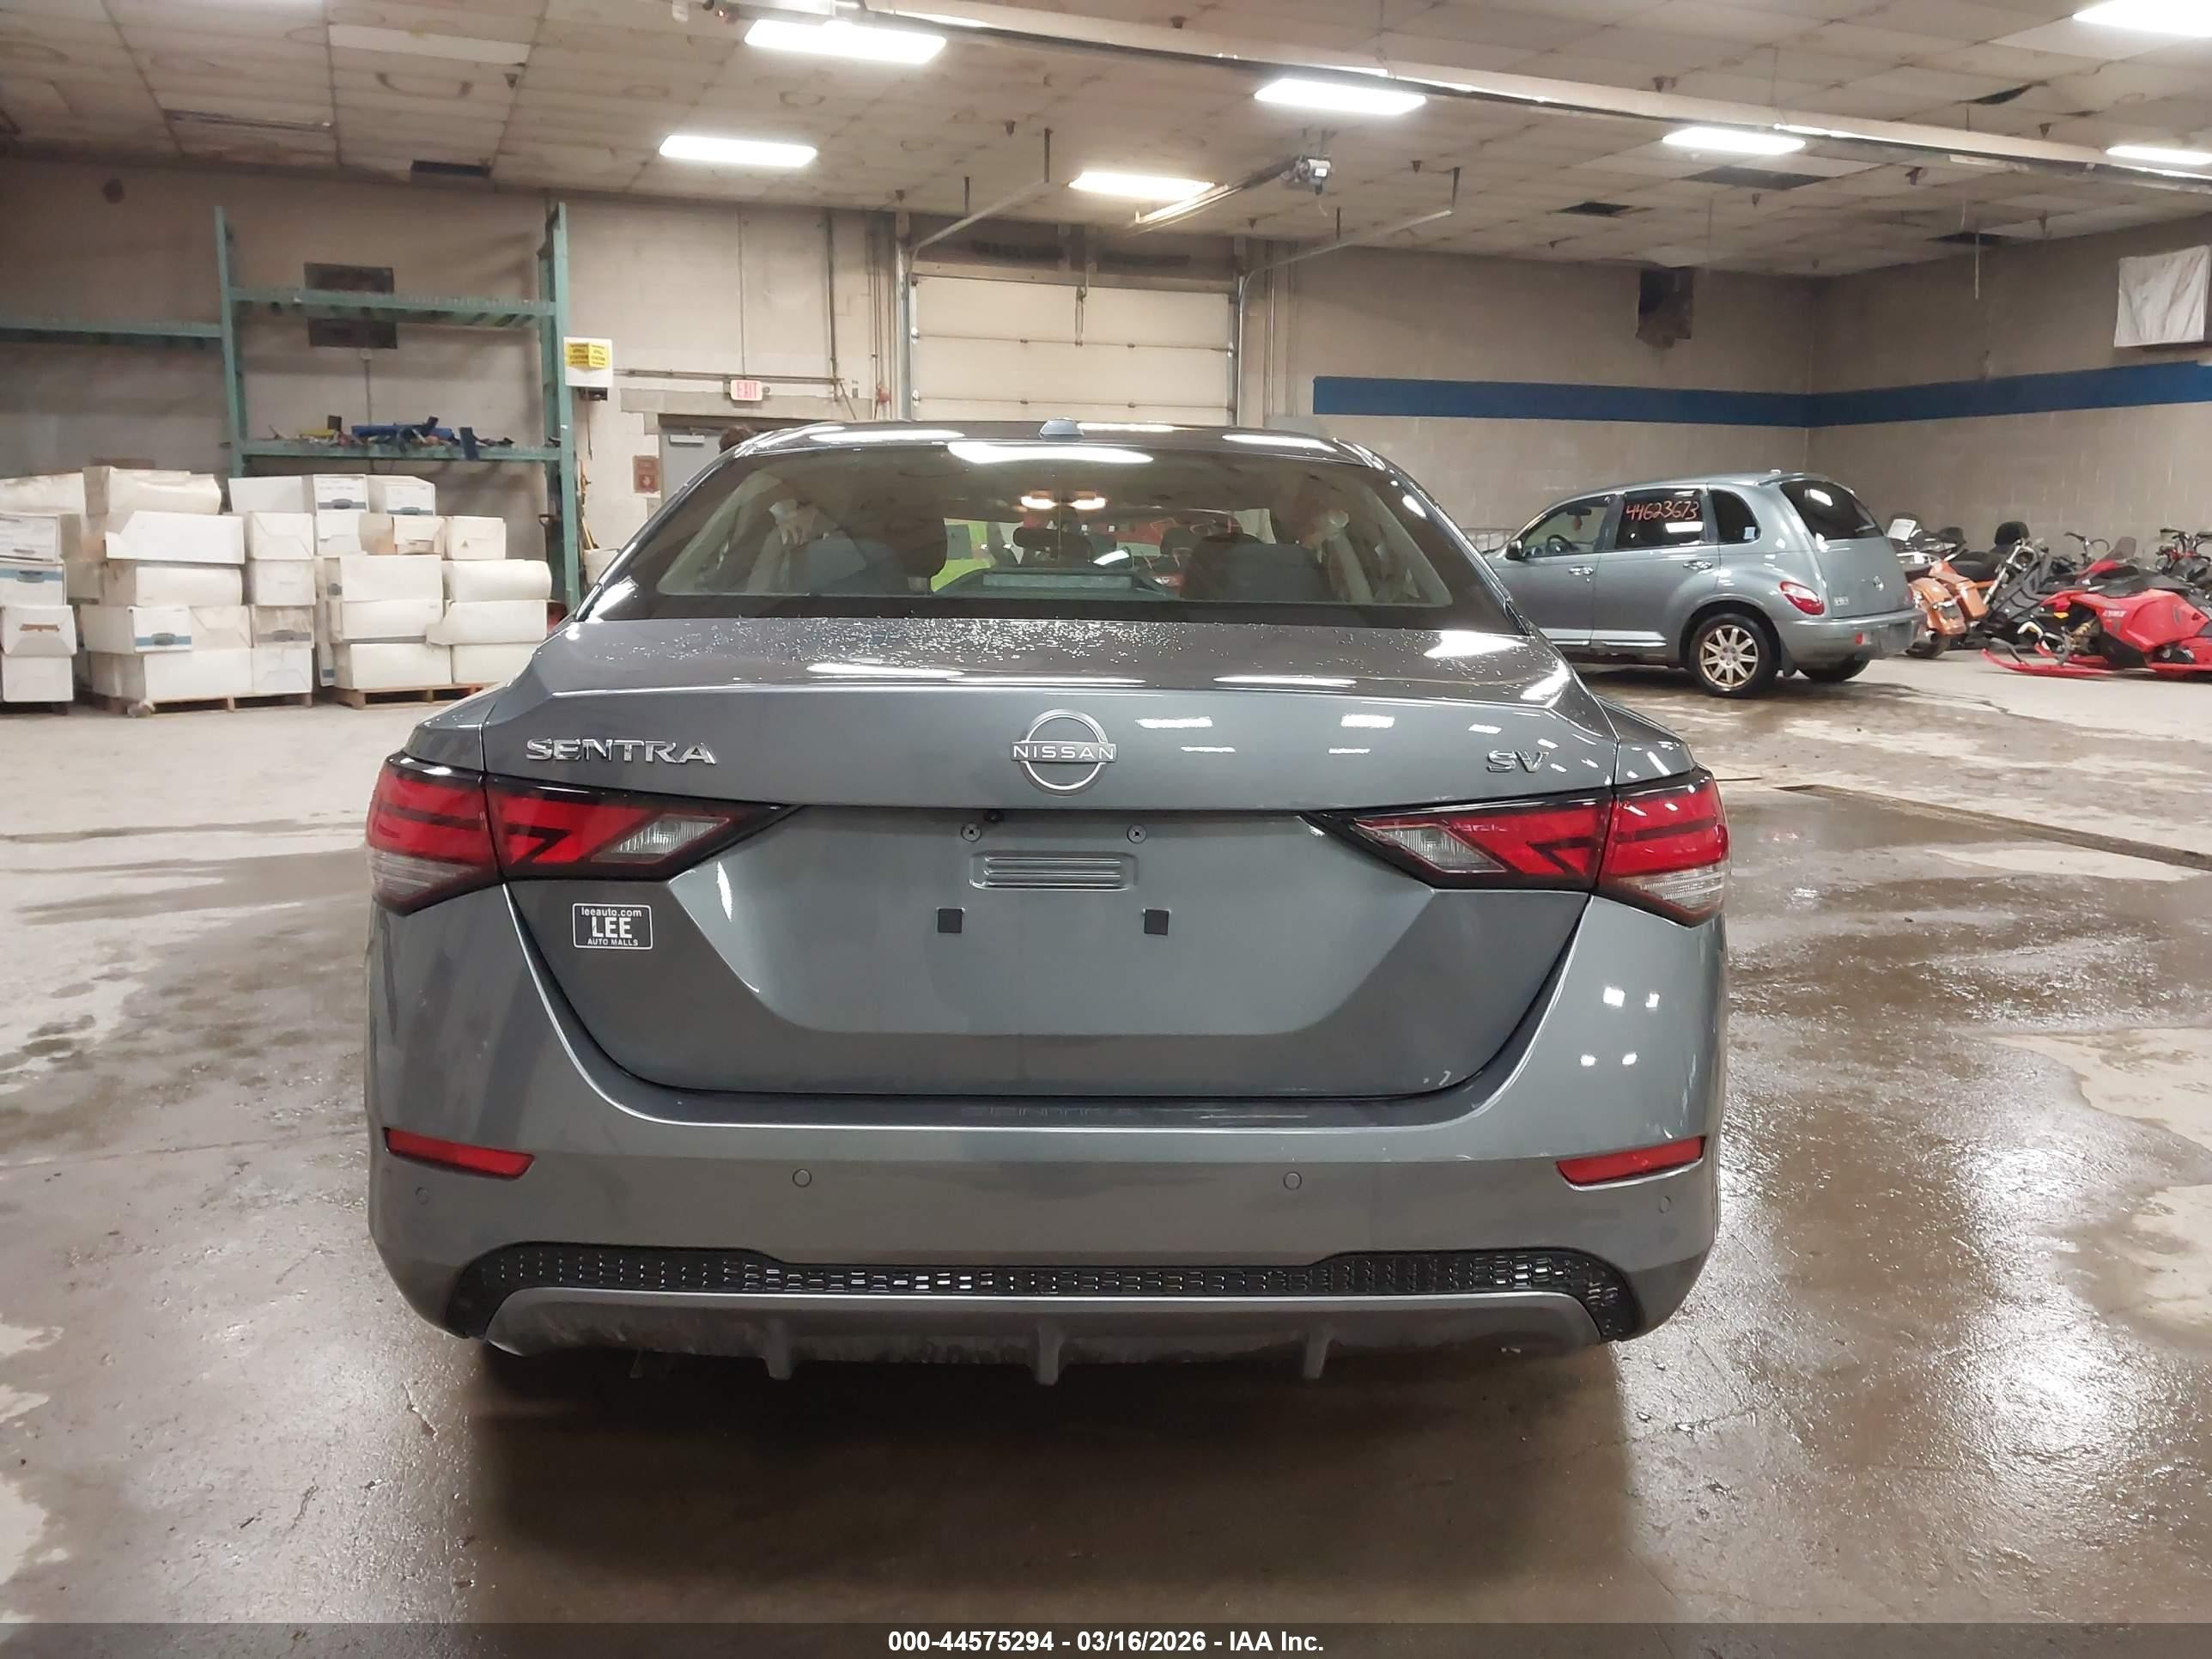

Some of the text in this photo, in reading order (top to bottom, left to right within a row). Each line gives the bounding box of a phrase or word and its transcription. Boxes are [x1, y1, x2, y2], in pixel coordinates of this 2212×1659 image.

[737, 381, 757, 398] EXIT
[526, 738, 717, 765] SENTRA
[1013, 745, 1114, 760] NISSAN
[1487, 750, 1549, 773] SV
[580, 907, 642, 918] leeauto.com
[591, 916, 633, 939] LEE
[587, 938, 639, 947] AUTO MALLS
